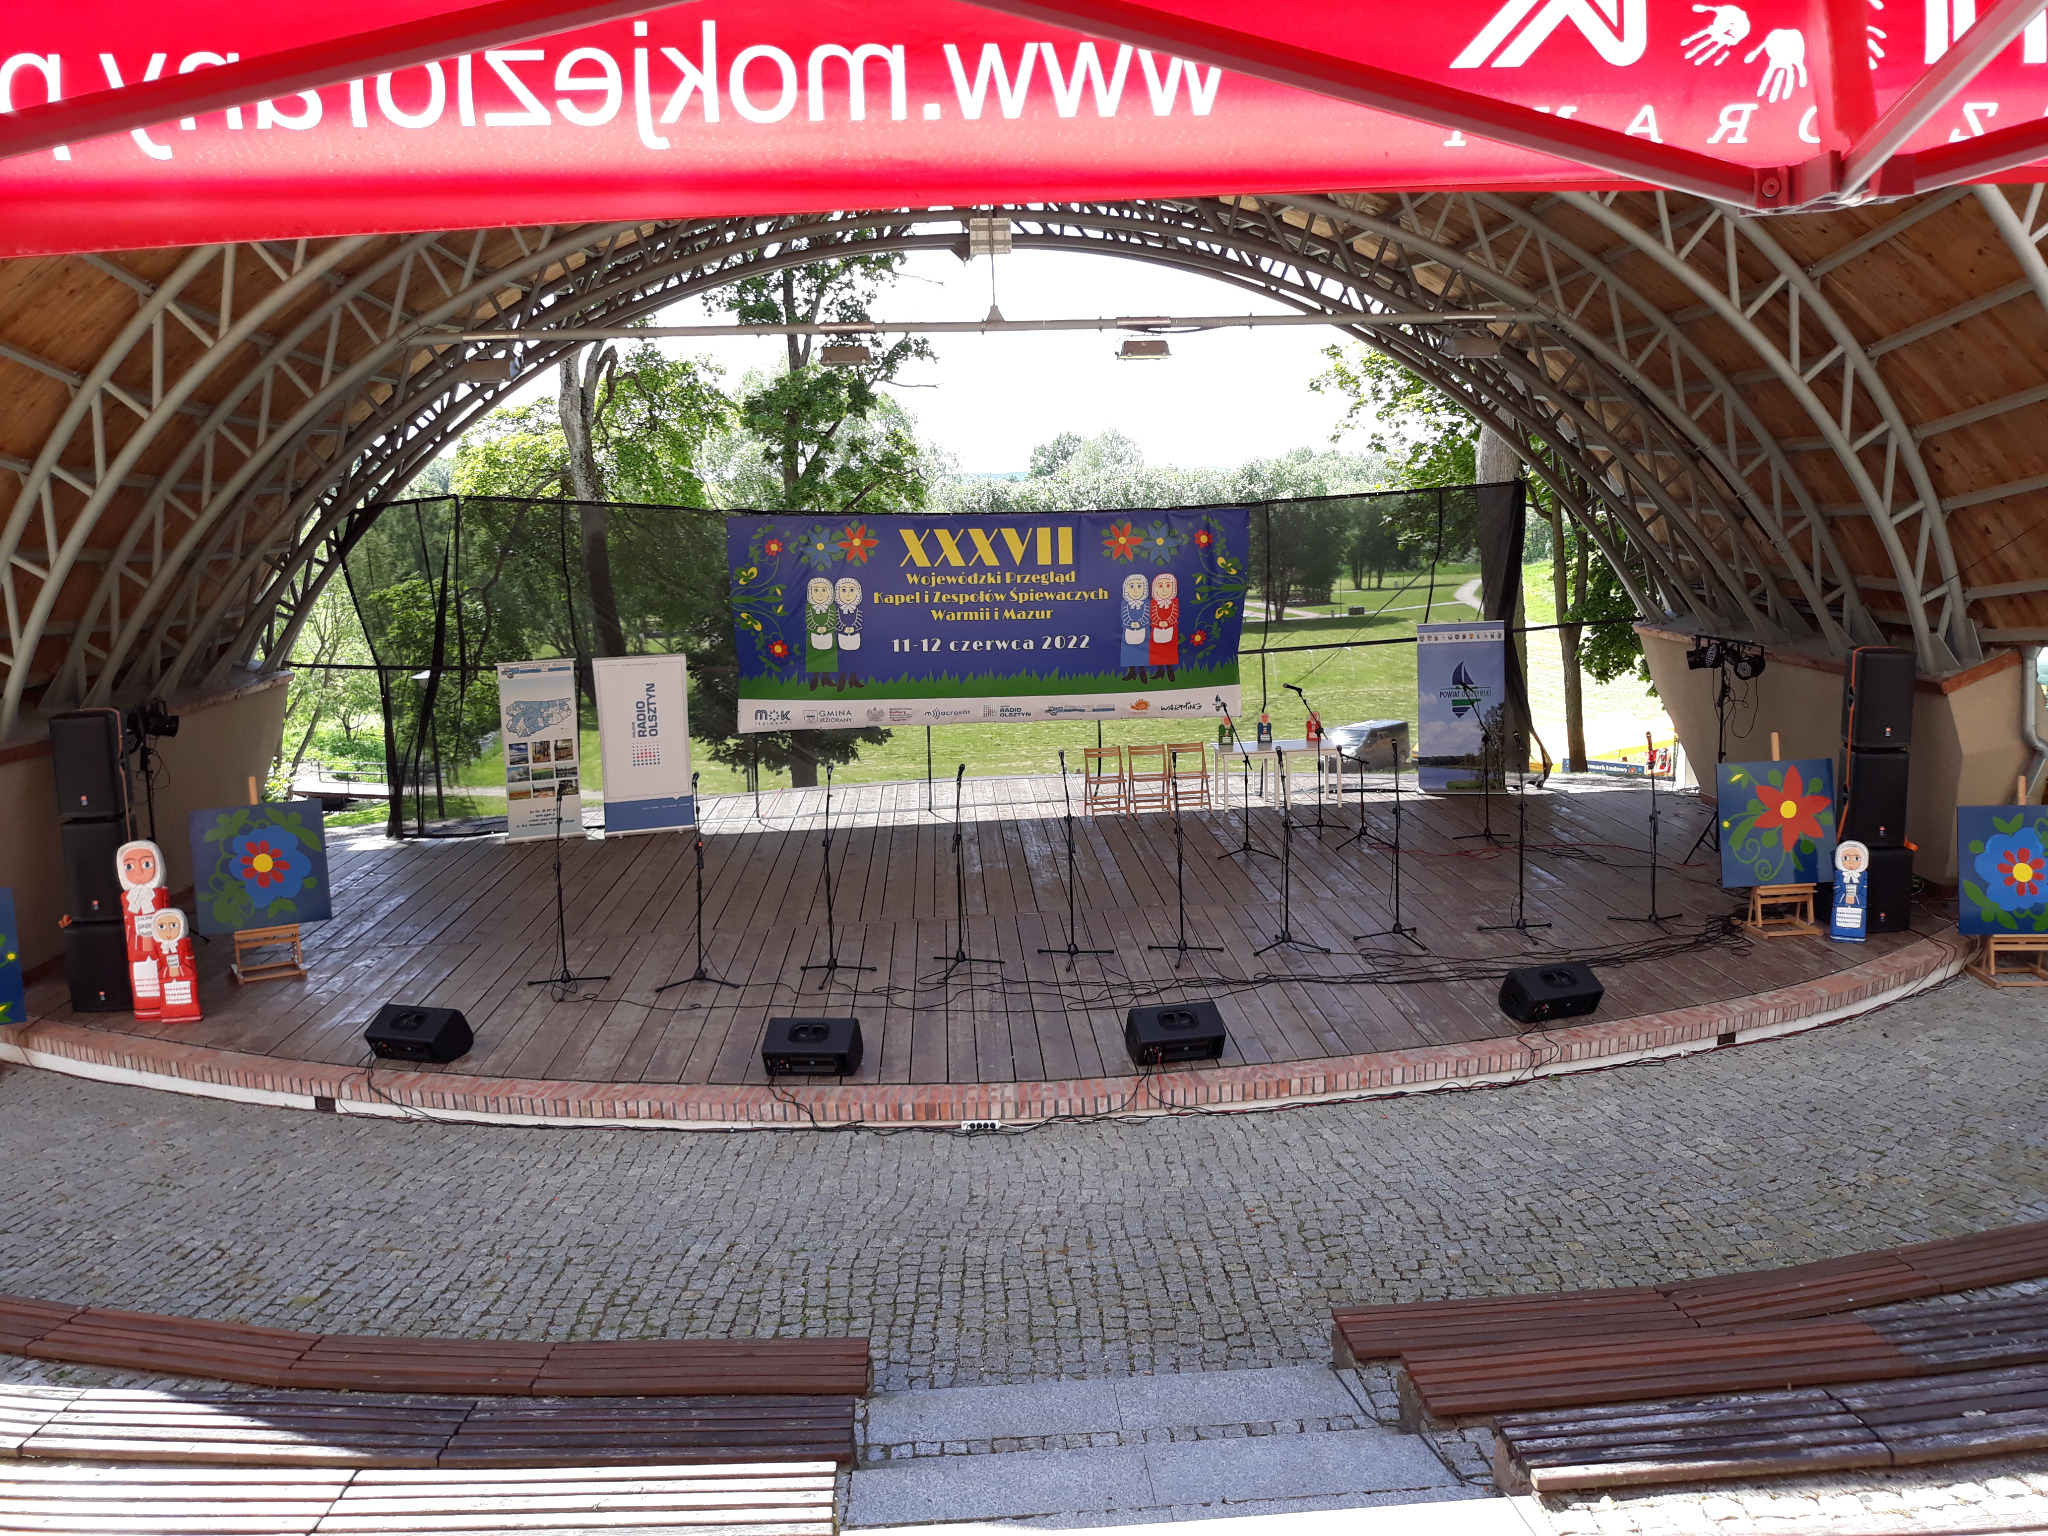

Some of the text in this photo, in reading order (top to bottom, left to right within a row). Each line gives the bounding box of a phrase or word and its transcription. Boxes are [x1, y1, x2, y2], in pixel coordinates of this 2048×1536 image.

[899, 527, 1073, 567] XXXVII
[906, 571, 1076, 587] Wojewódzki Przegląd
[873, 587, 1109, 605] Kapel i Zespołów Śpiewaczych
[931, 608, 1053, 621] Warmii i Mazur
[891, 635, 1090, 653] 11-12 czerwca 2022
[636, 701, 647, 737] RADIO
[646, 683, 658, 737] OLSZTYN
[818, 709, 852, 718] GMINA
